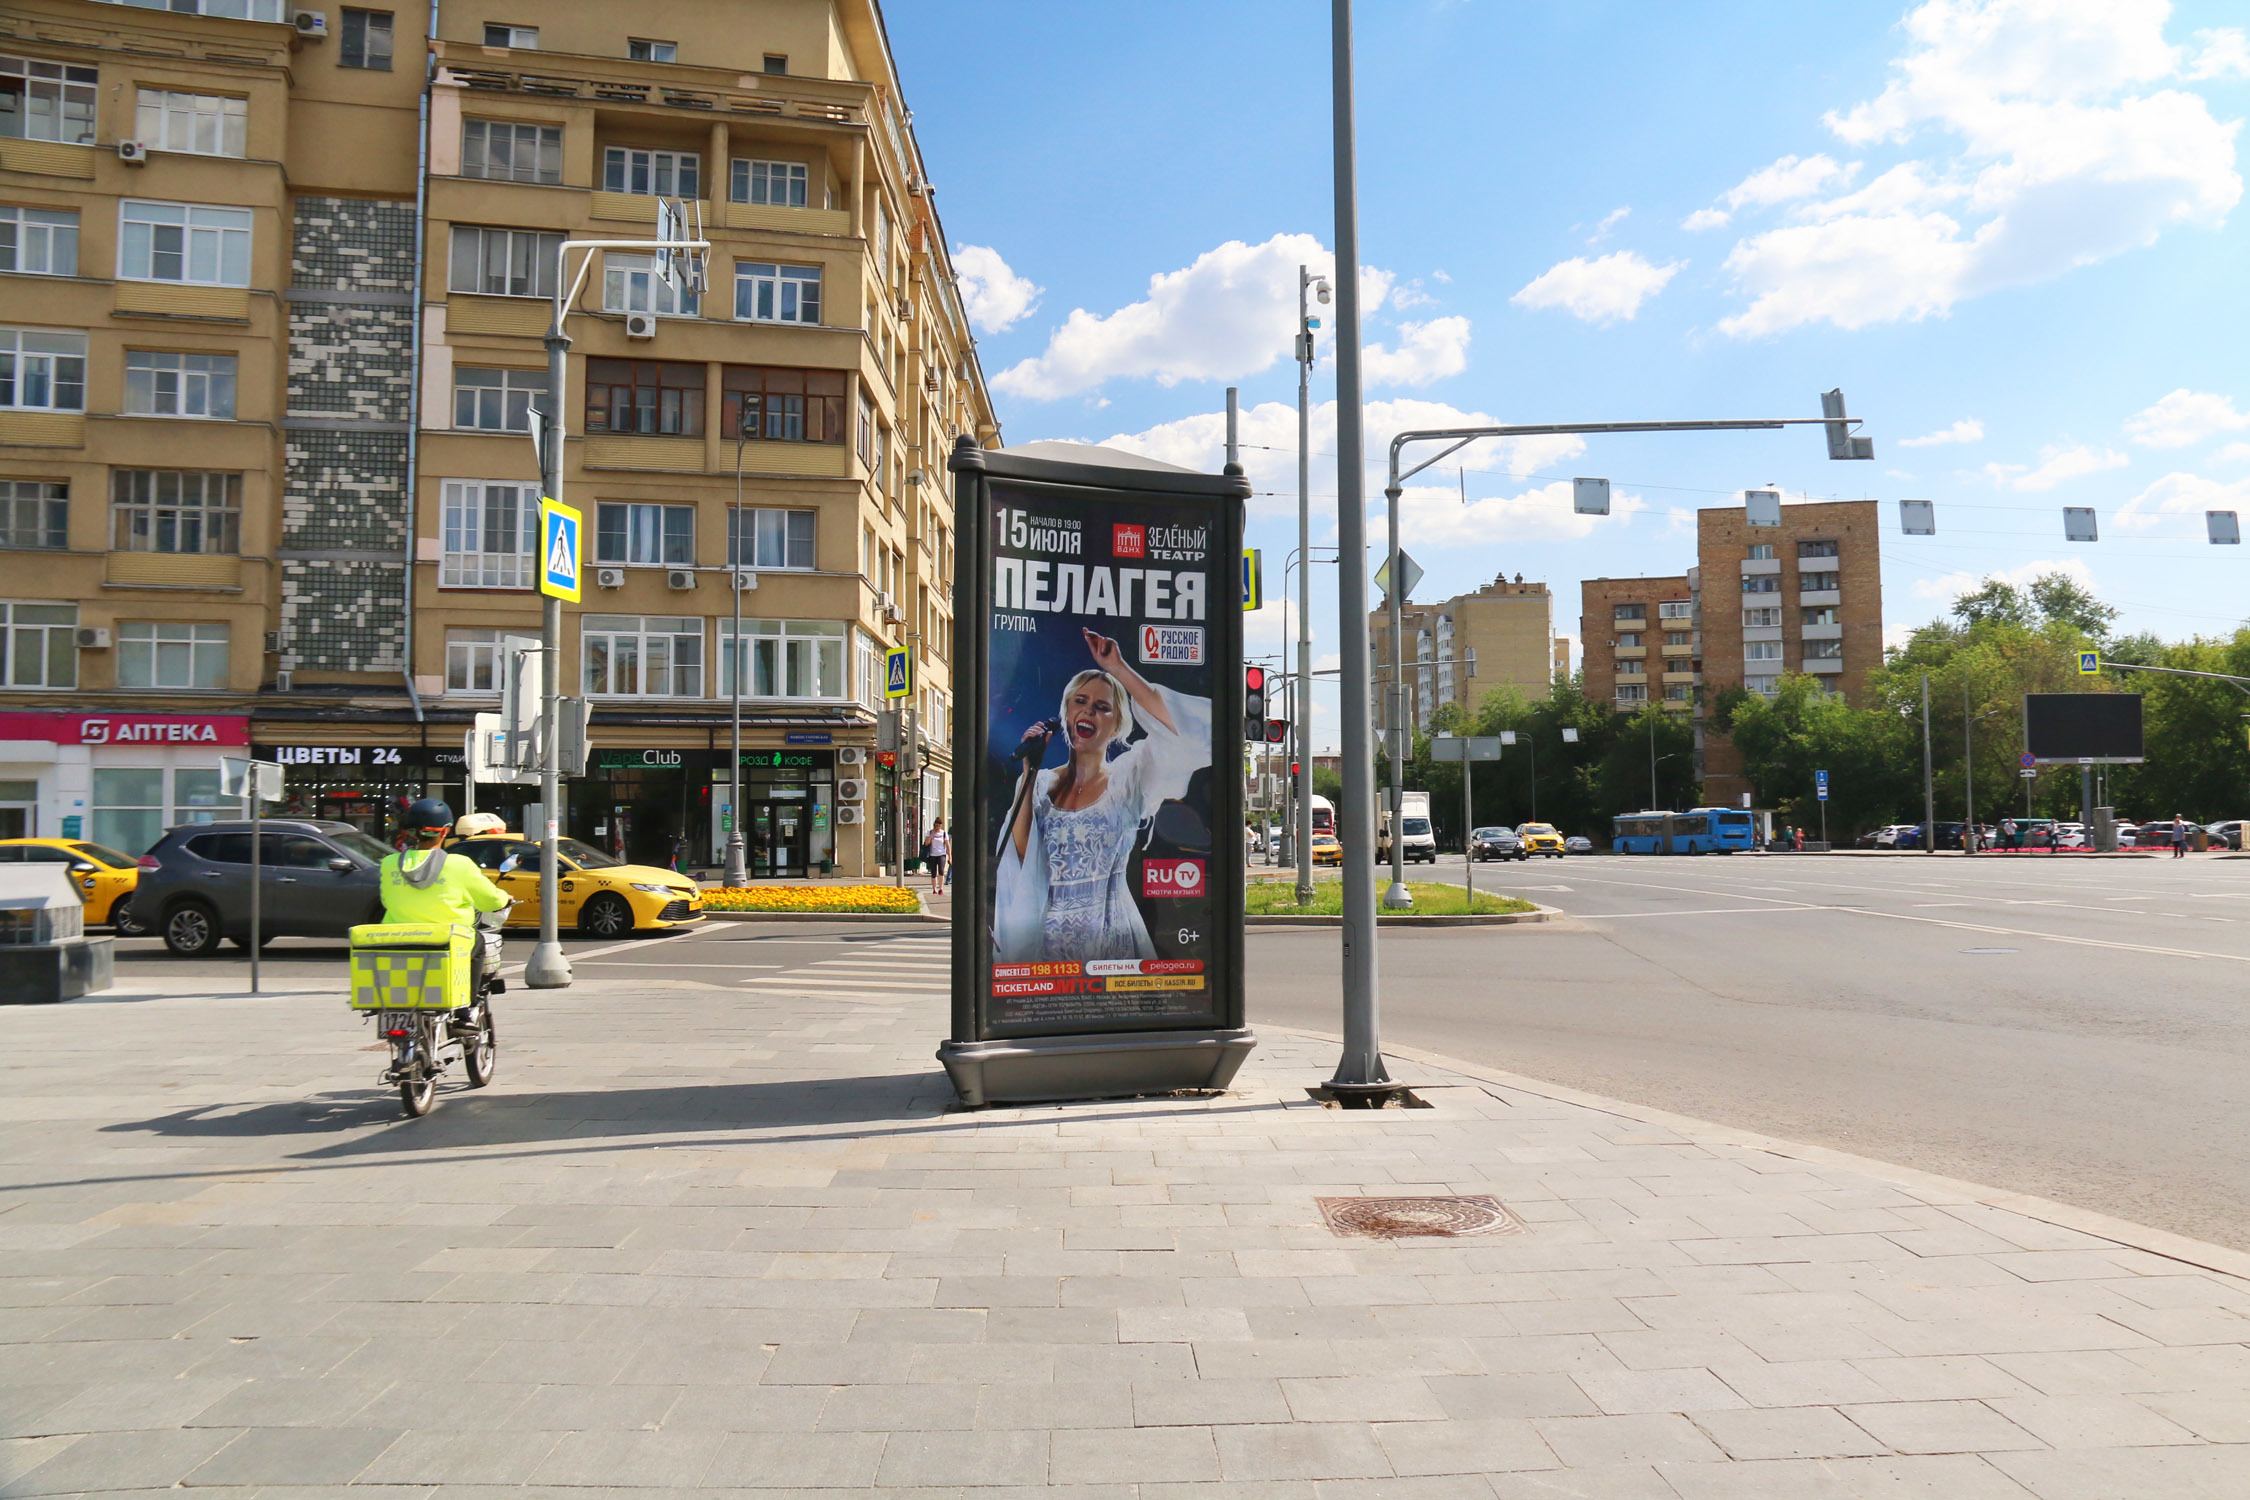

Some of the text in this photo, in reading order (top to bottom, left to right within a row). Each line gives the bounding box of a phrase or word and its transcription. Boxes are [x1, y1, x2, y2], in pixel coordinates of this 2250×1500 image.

[1030, 516, 1082, 530] НАЧАЛО В 19:00
[996, 508, 1081, 554] 15 ИЮЛЯ
[1148, 523, 1206, 549] ЗЕЛЁНЫЙ
[1150, 549, 1206, 561] ТЕАТР
[995, 556, 1206, 621] ПЕЛАГЕЯ
[994, 613, 1037, 632] ГРУППА
[1161, 630, 1199, 645] РУССКОЕ
[116, 723, 218, 741] АПТЕКА
[276, 747, 402, 764] ЦВЕТЫ 24
[435, 754, 466, 764] СТУДИ
[600, 749, 682, 765] VapeClub
[738, 756, 812, 766] РОЗД КОФЕ
[1147, 868, 1196, 884] RU TV
[1178, 928, 1200, 944] 6+
[1031, 964, 1051, 975] 198
[1053, 963, 1080, 975] 1133
[1150, 961, 1195, 971] pelagea.ru
[995, 982, 1054, 993] TICKETLAND
[1114, 979, 1154, 988] ВСЕ БИЛЕТЫ
